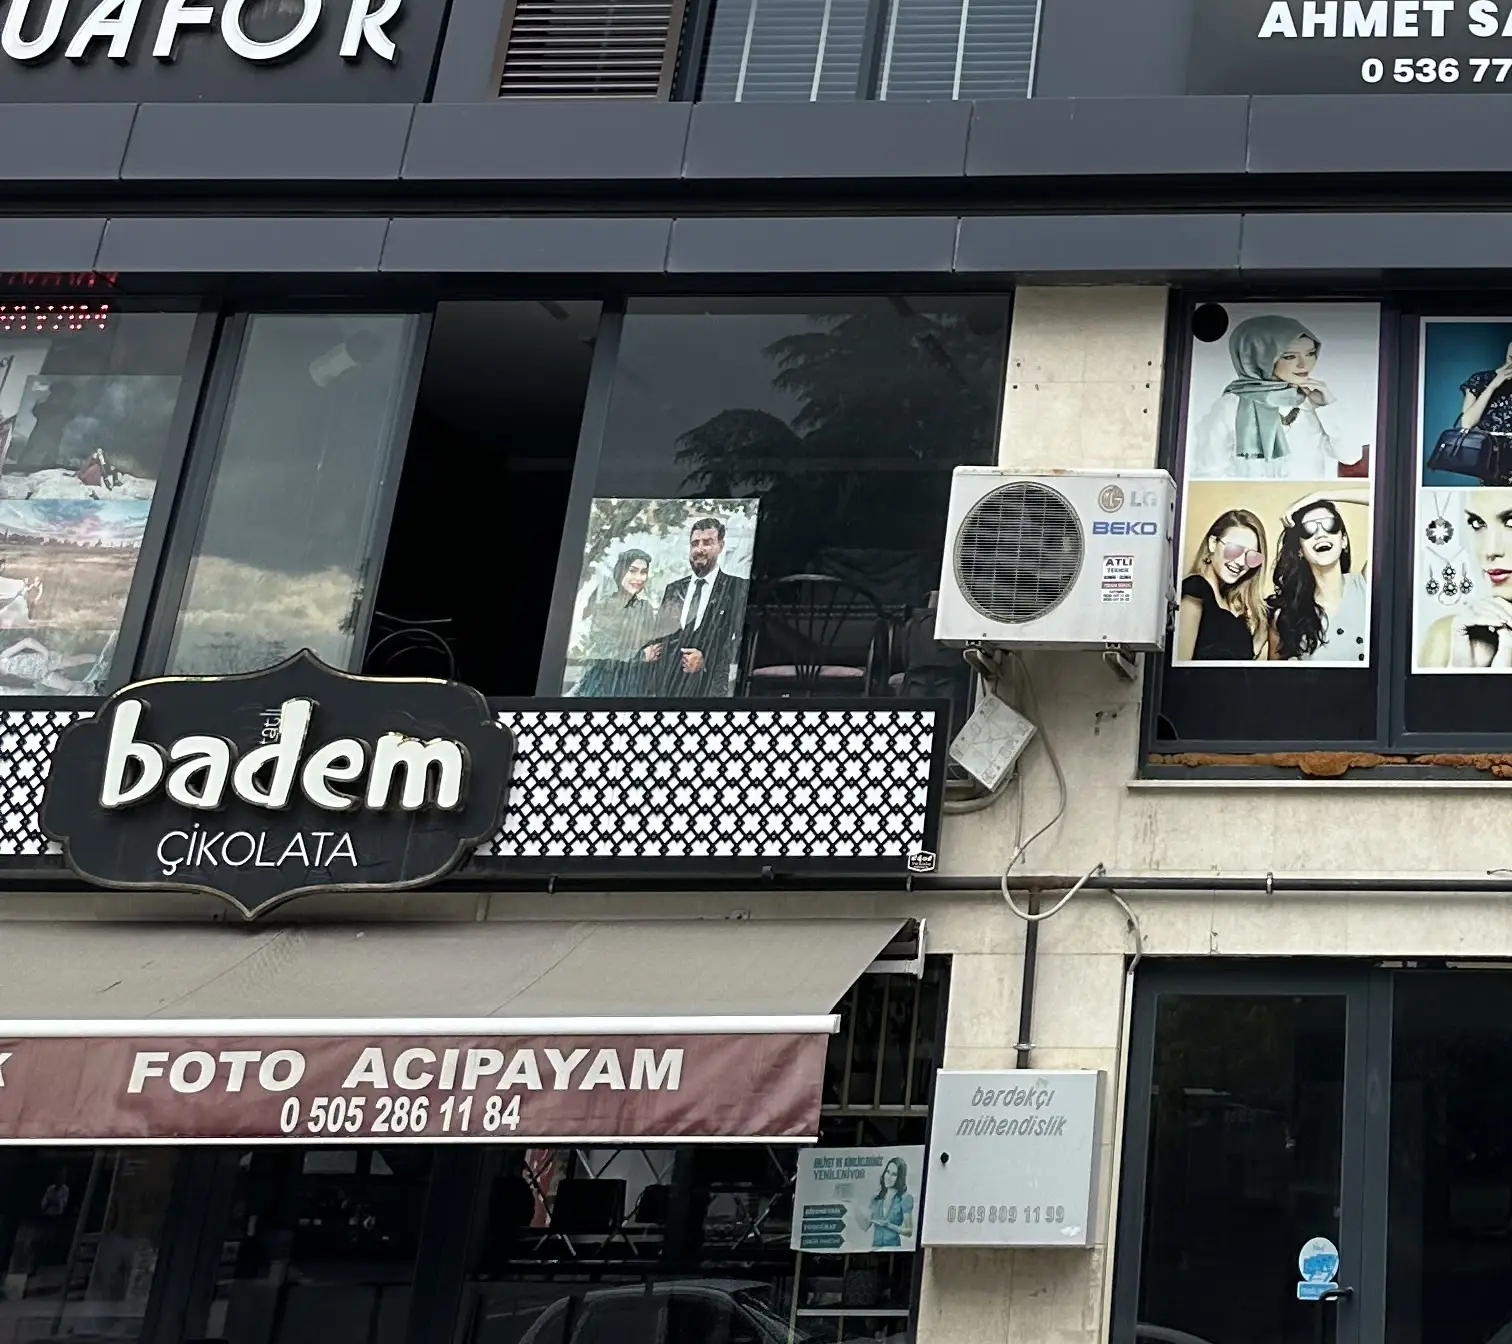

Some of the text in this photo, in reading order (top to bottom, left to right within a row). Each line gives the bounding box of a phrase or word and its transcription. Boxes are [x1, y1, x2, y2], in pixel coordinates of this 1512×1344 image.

[1257, 0, 1454, 39] AHMET
[1361, 58, 1384, 84] 0
[1392, 58, 1460, 84] 536
[1092, 521, 1157, 535] BEKO
[99, 698, 466, 810] badem
[157, 823, 358, 876] ÇİKOLATA
[127, 1047, 684, 1094] FOTO ACIPAYAM
[280, 1095, 521, 1133] 0 505 286 11 84
[971, 1086, 1055, 1110] bardakçı
[956, 1115, 1067, 1137] mühendislik
[1024, 1205, 1041, 1223] 11
